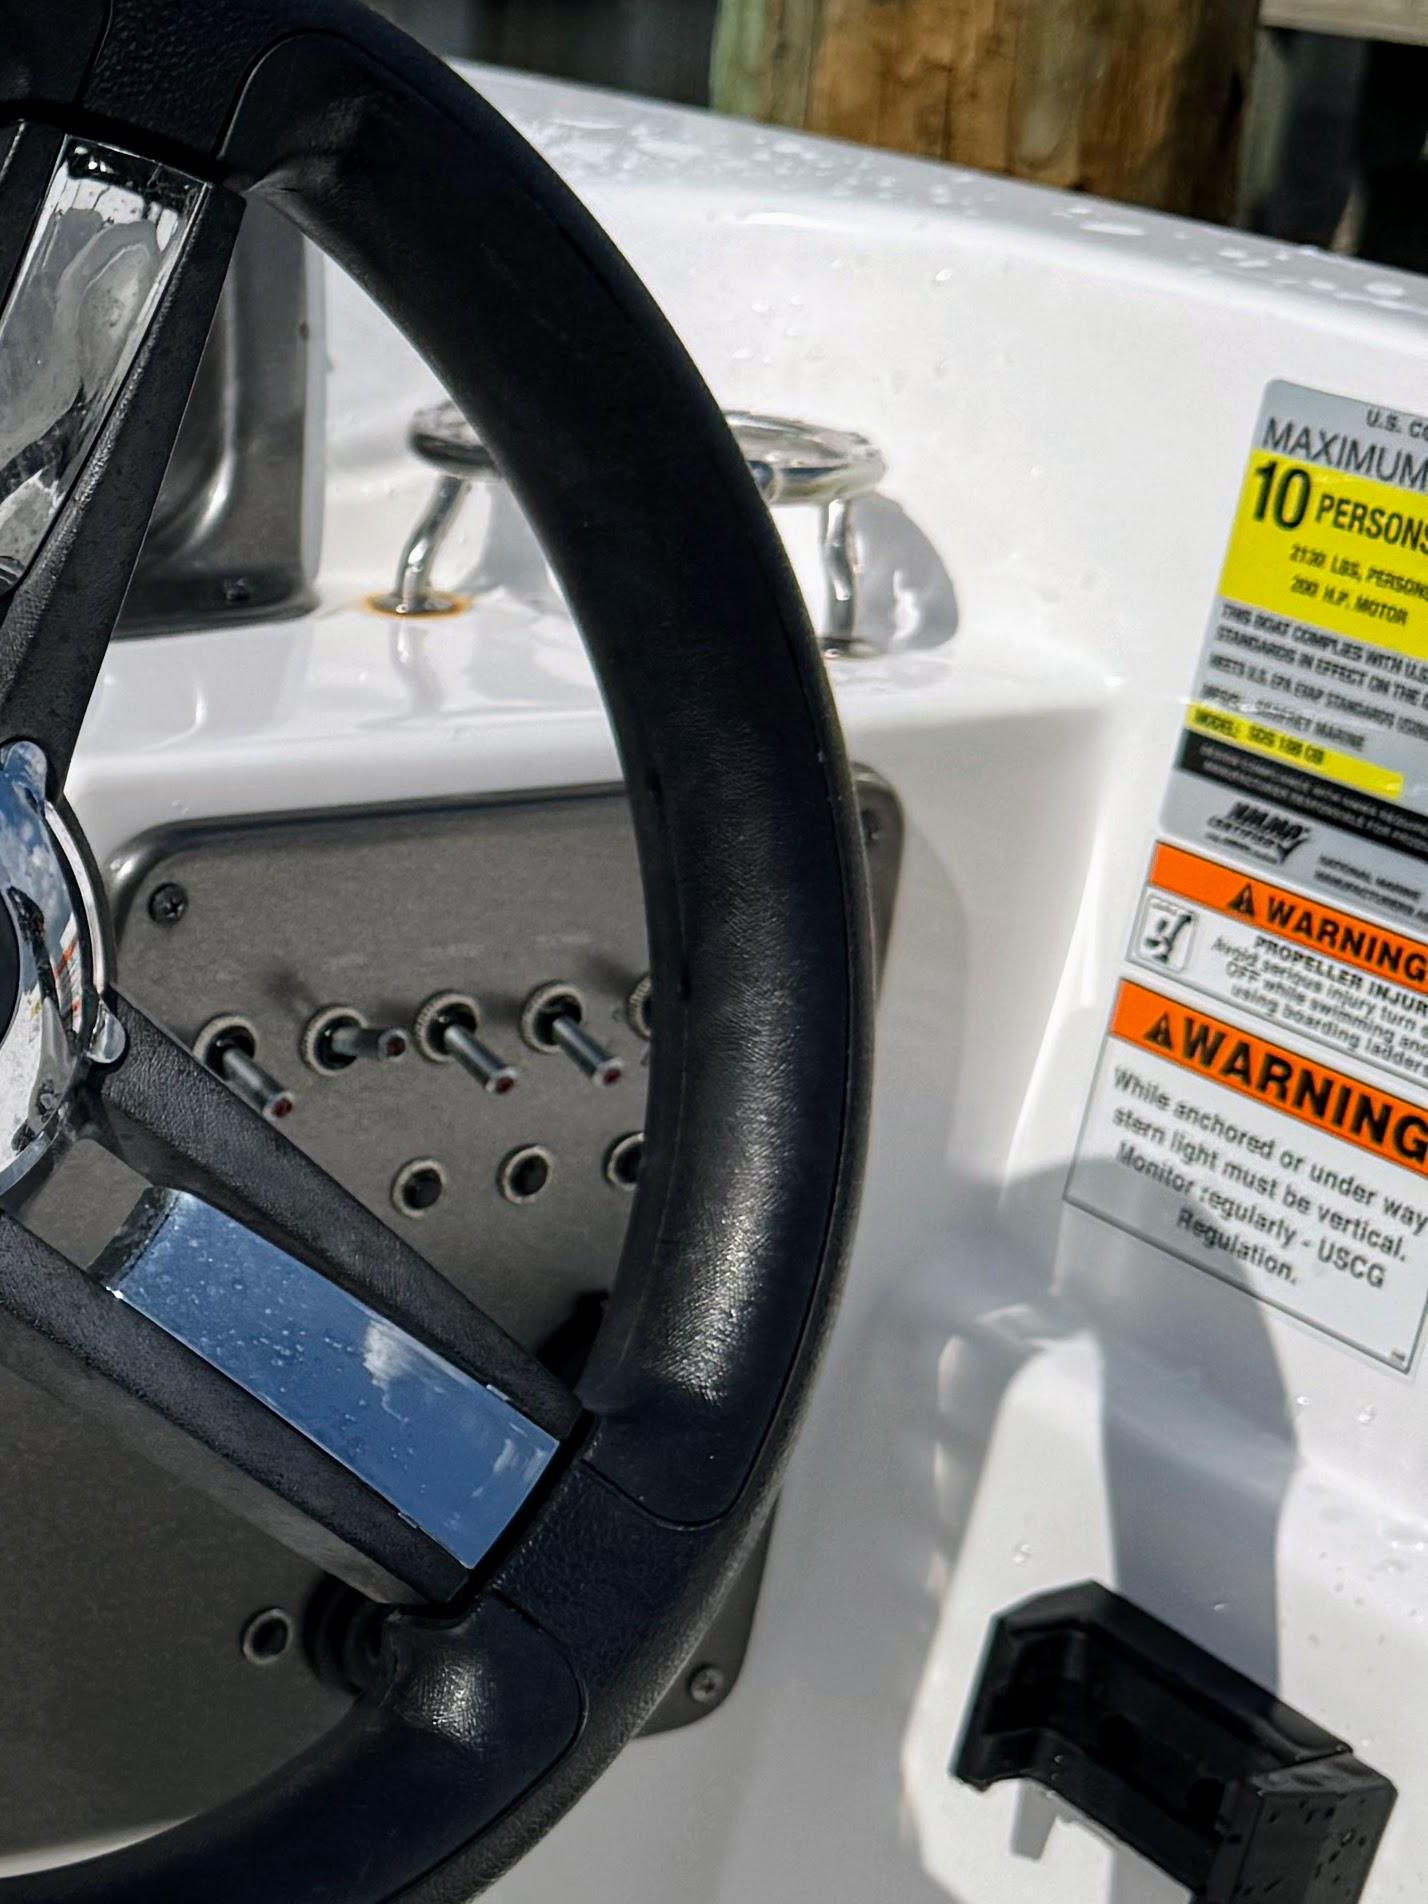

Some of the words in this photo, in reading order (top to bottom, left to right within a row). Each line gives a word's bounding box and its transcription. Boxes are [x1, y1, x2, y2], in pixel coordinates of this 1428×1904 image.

[1261, 416, 1428, 493] MAXIMUM
[1254, 460, 1312, 532] 10
[1354, 595, 1408, 626] MOTOR
[1255, 935, 1363, 992] PROPELLER
[1267, 895, 1427, 984] WARNING
[1283, 1003, 1360, 1053] boarding
[1310, 997, 1395, 1044] swimming
[1327, 983, 1376, 1019] injury
[1381, 1005, 1417, 1033] turn
[1181, 1016, 1428, 1165] WARNING
[1112, 1106, 1166, 1145] stern
[1170, 1129, 1219, 1171] light
[1221, 1160, 1278, 1200] must
[1282, 1183, 1312, 1215] be
[1317, 1203, 1407, 1262] vertical.
[1114, 1067, 1171, 1111] While
[1173, 1100, 1275, 1160] anchored
[1279, 1150, 1304, 1172] or
[1309, 1163, 1377, 1206] under
[1382, 1197, 1428, 1236] way
[1116, 1140, 1195, 1195] Monitor
[1199, 1186, 1297, 1249] regularly
[1317, 1236, 1387, 1289] USCG
[1176, 1207, 1298, 1285] Regulation.
